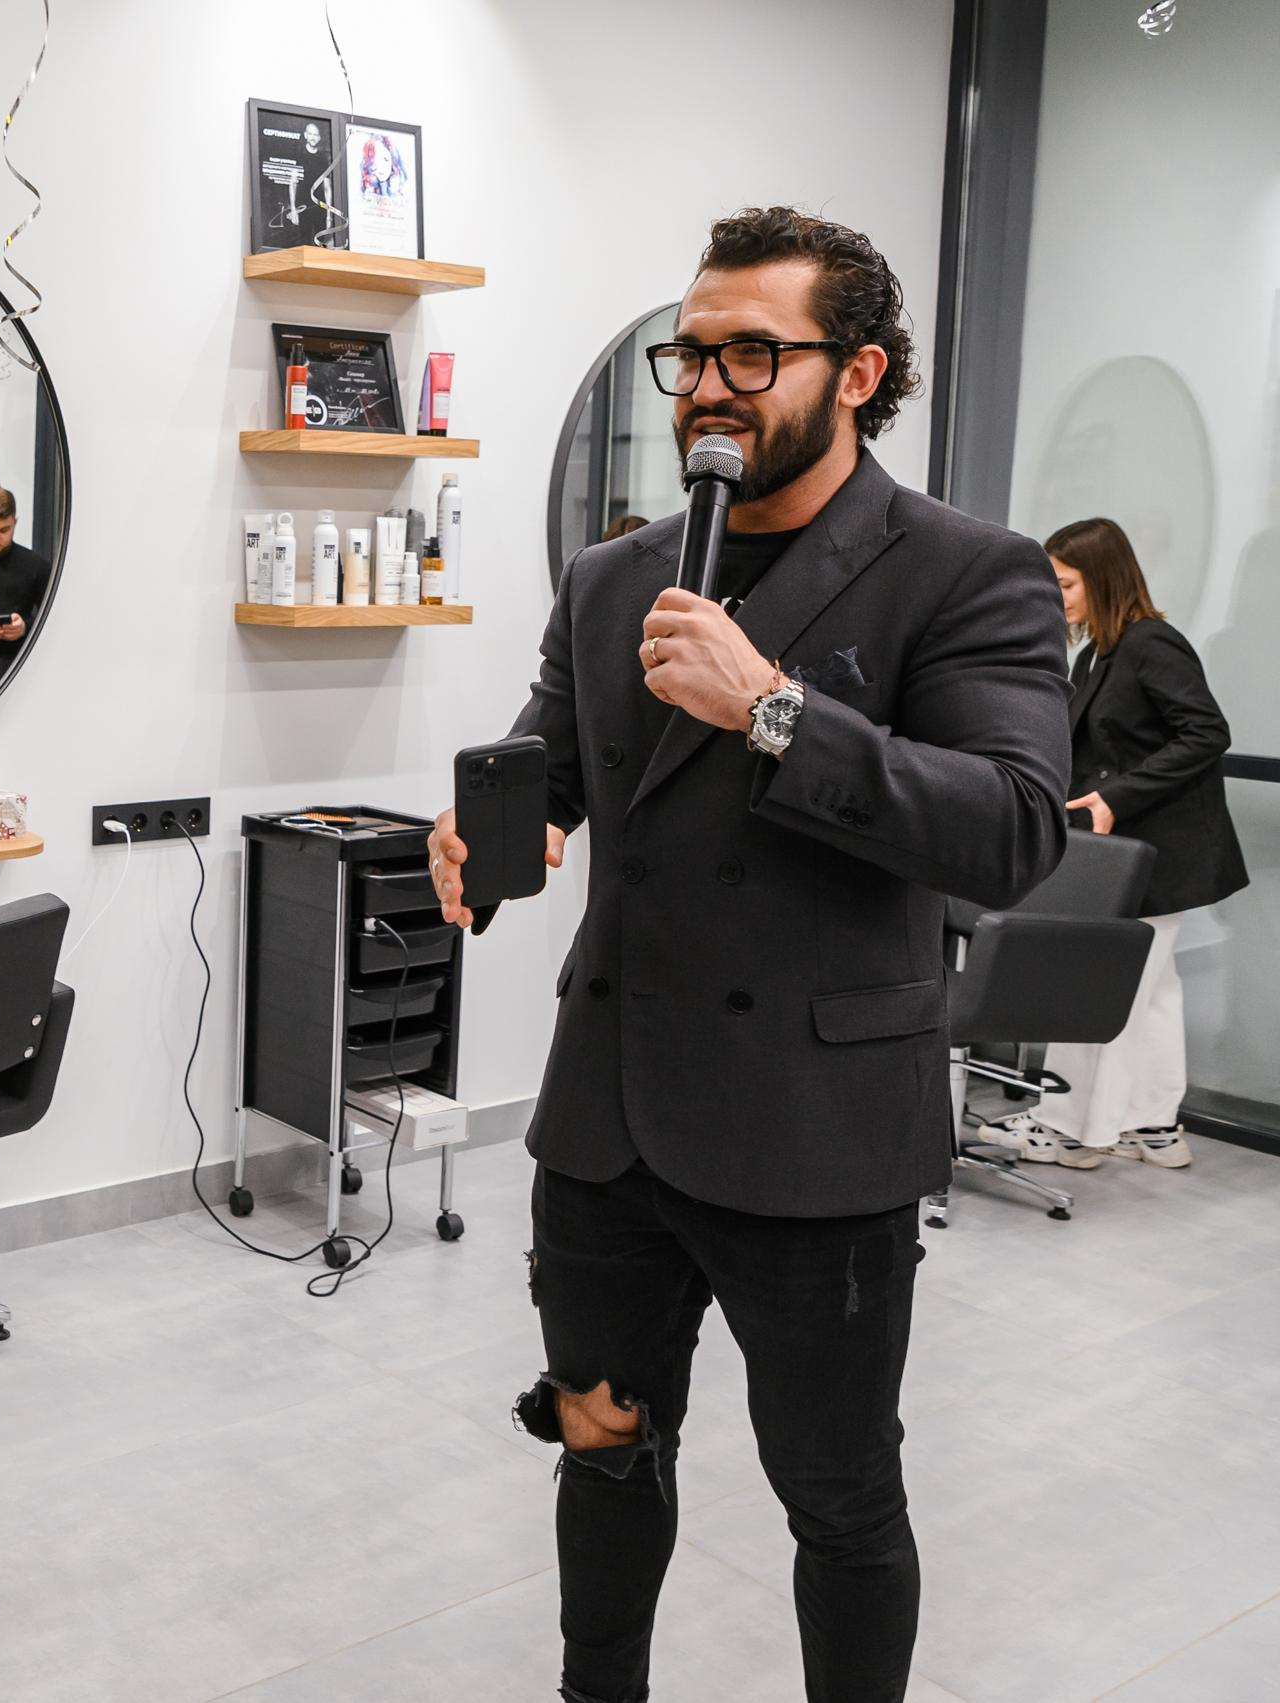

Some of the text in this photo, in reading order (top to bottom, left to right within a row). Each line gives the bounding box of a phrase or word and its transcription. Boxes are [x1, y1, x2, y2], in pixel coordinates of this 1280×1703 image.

[247, 538, 260, 548] ART
[275, 551, 286, 560] ART
[324, 550, 336, 560] ART
